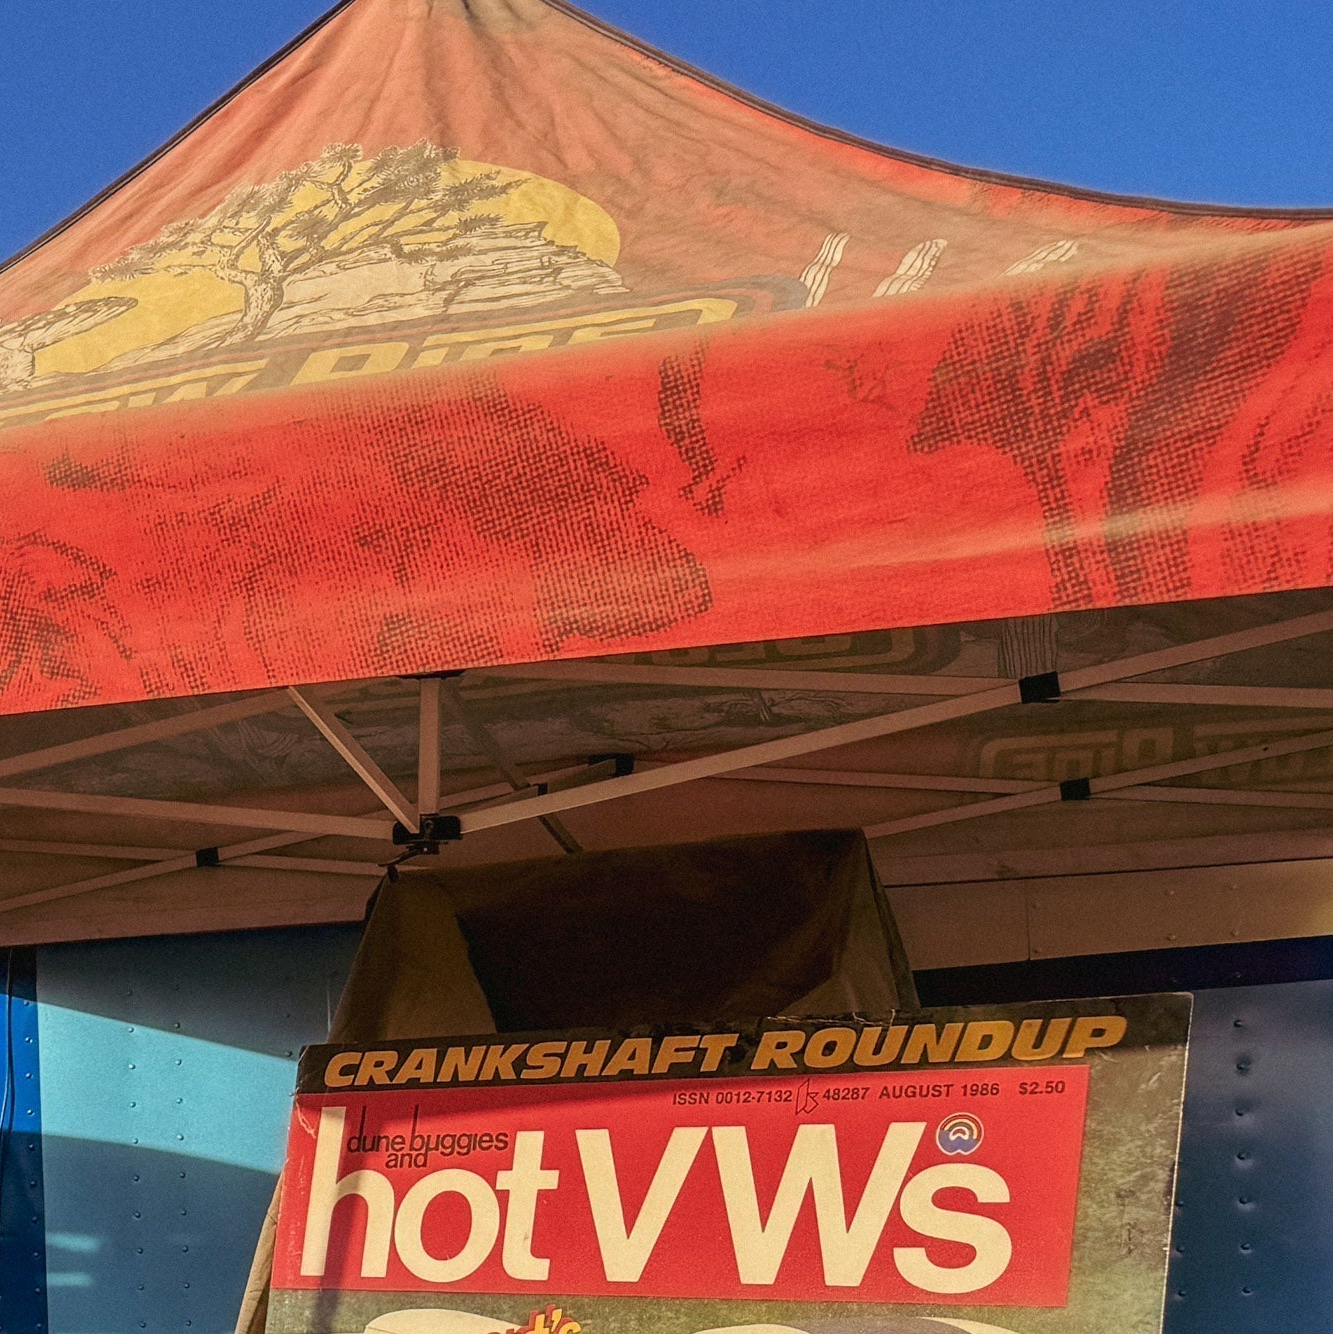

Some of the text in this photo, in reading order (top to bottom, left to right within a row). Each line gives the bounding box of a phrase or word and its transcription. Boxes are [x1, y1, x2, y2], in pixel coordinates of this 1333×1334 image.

[323, 1016, 1128, 1088] CRANKSHAFT ROUNDUP
[672, 1080, 1066, 1106] ISSN 0012-7132 48287 AUGUST 1986 $2.50
[347, 1104, 510, 1156] dune buggies
[385, 1145, 427, 1169] and
[299, 1107, 1013, 1294] hot VWs
